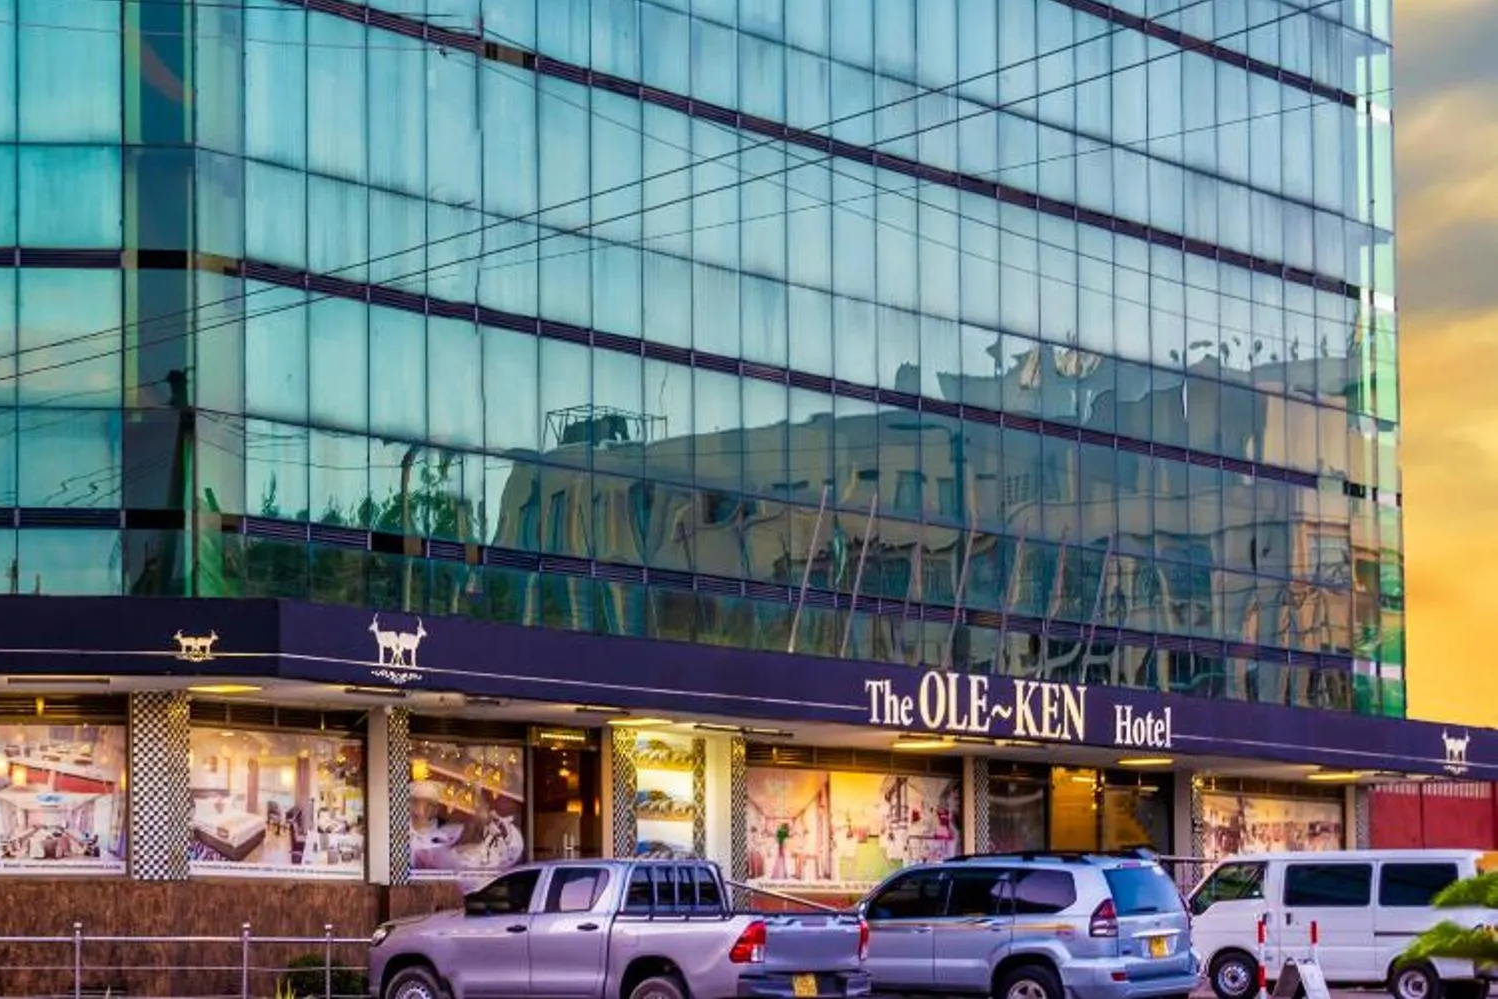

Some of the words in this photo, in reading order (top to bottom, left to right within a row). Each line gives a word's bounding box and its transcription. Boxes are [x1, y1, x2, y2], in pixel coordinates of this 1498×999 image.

[865, 679, 914, 726] The
[918, 670, 1087, 742] OLE~KEN
[1114, 704, 1172, 748] Hotel
